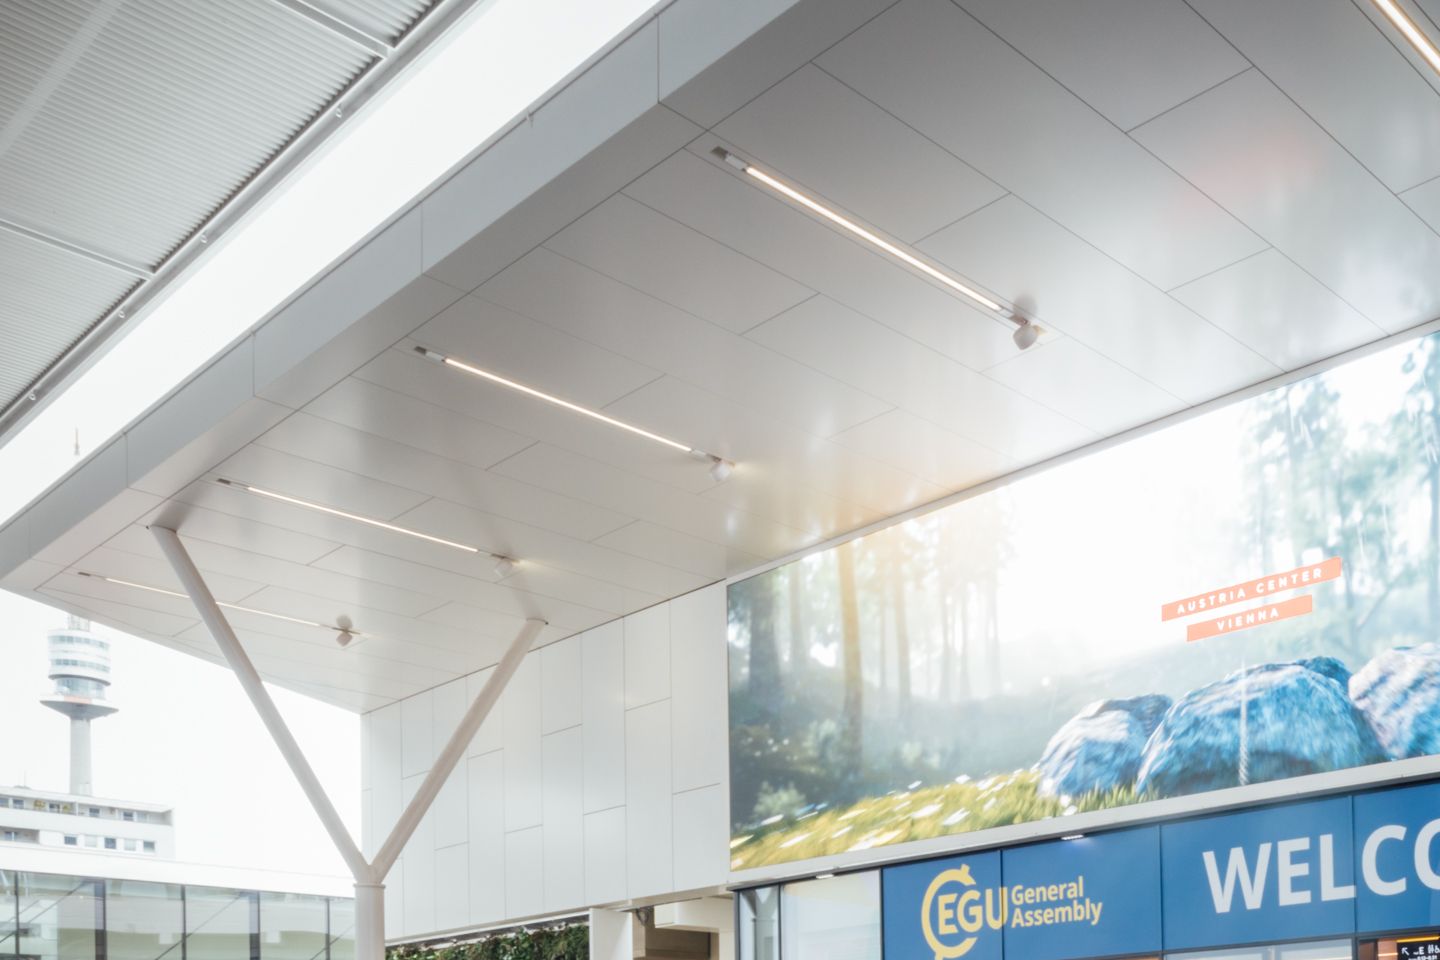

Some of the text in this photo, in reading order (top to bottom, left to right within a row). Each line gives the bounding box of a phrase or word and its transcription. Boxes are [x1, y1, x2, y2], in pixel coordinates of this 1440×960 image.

[1177, 568, 1323, 614] AUSTRIA CENTER
[1216, 607, 1279, 631] VIENNA
[937, 876, 1084, 935] EGU General
[1011, 897, 1103, 929] Assembly
